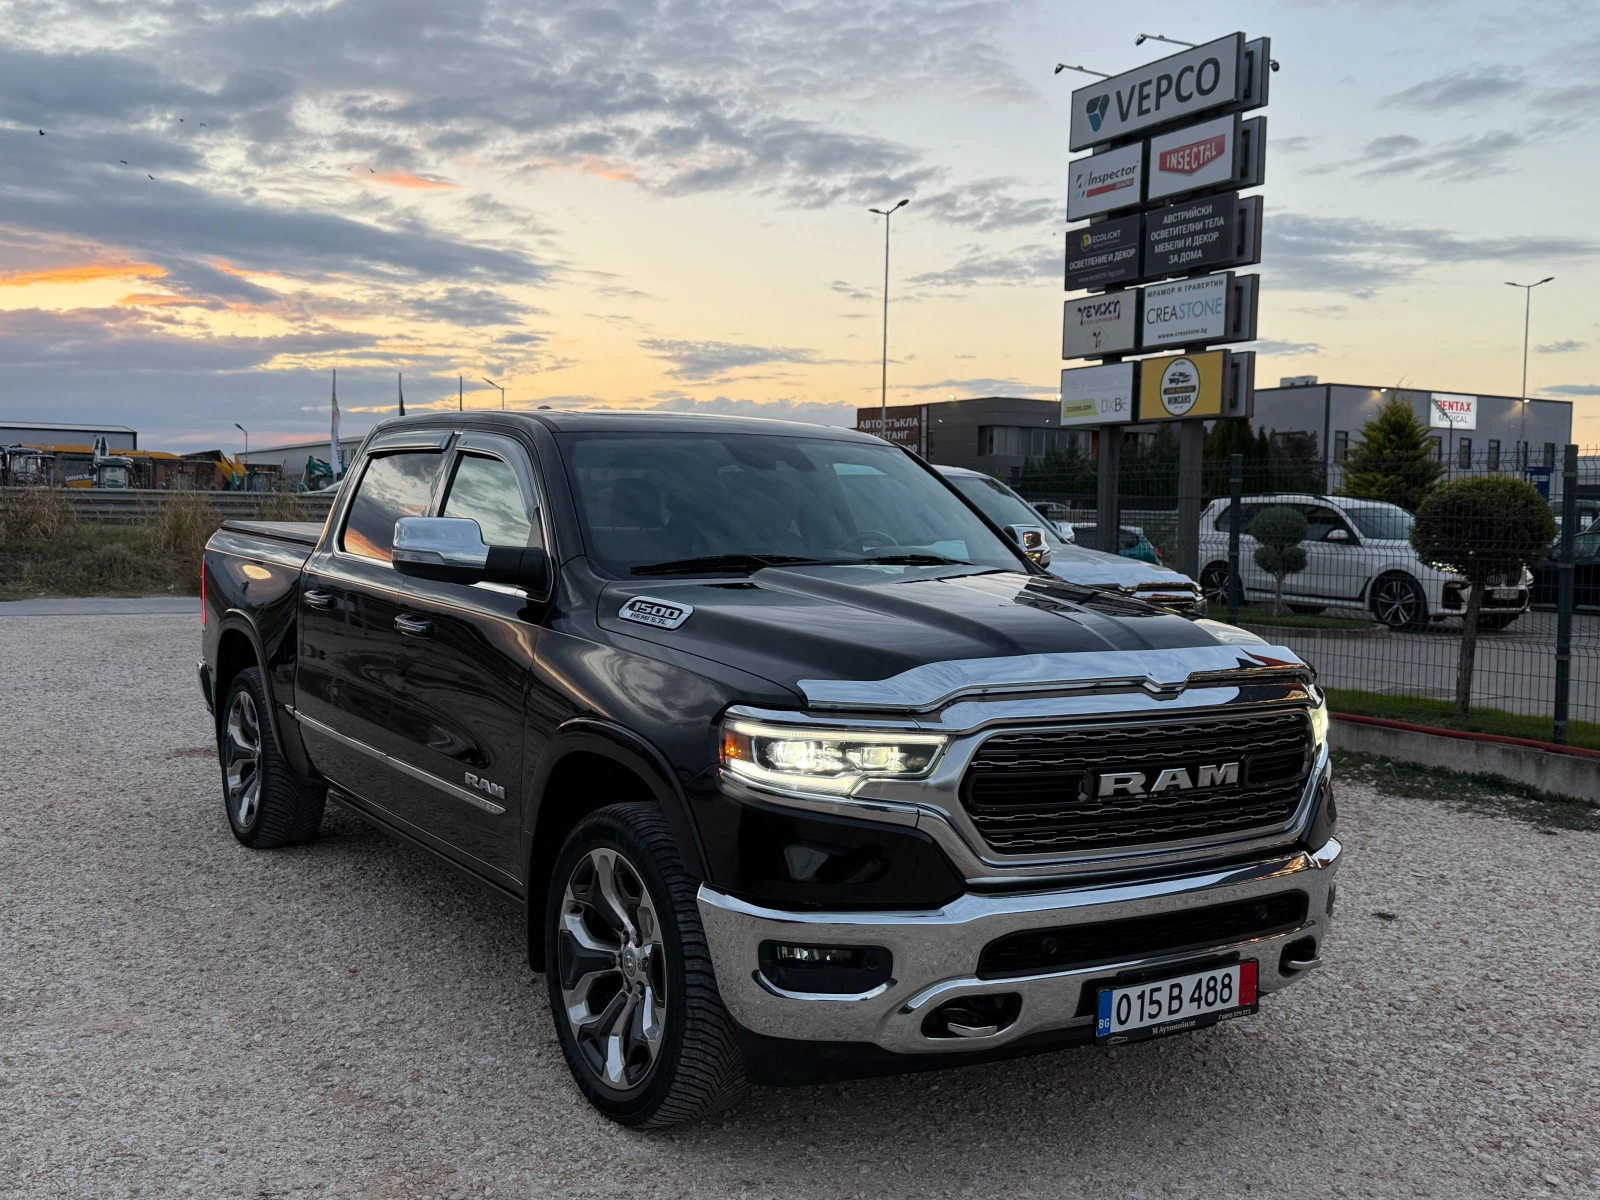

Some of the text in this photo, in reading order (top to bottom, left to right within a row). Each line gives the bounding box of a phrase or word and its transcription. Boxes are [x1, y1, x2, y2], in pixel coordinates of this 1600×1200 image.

[1115, 57, 1221, 122] VEPCO
[1166, 142, 1217, 170] INSECTAL
[1088, 165, 1137, 186] Inspector
[1162, 205, 1213, 225] АВСТРИЙСКИ
[1150, 216, 1225, 241] ОСВЕТИТЕЛНИ ТЕЛА
[1154, 232, 1220, 254] МЕБЕЛИ И ДЕКОР
[1069, 248, 1136, 270] ОСВЕТЛЕНИЕ И ДЕКОР
[1168, 249, 1203, 265] ЗА ДОМА
[1147, 279, 1224, 298] МРАМОР И ТРАВЕРТИН
[1146, 297, 1223, 325] CREASTONE
[629, 611, 650, 621] HEMI
[633, 601, 681, 619] 1500
[464, 771, 506, 800] RAM
[1098, 762, 1239, 797] RAM
[1098, 1017, 1110, 1030] BG
